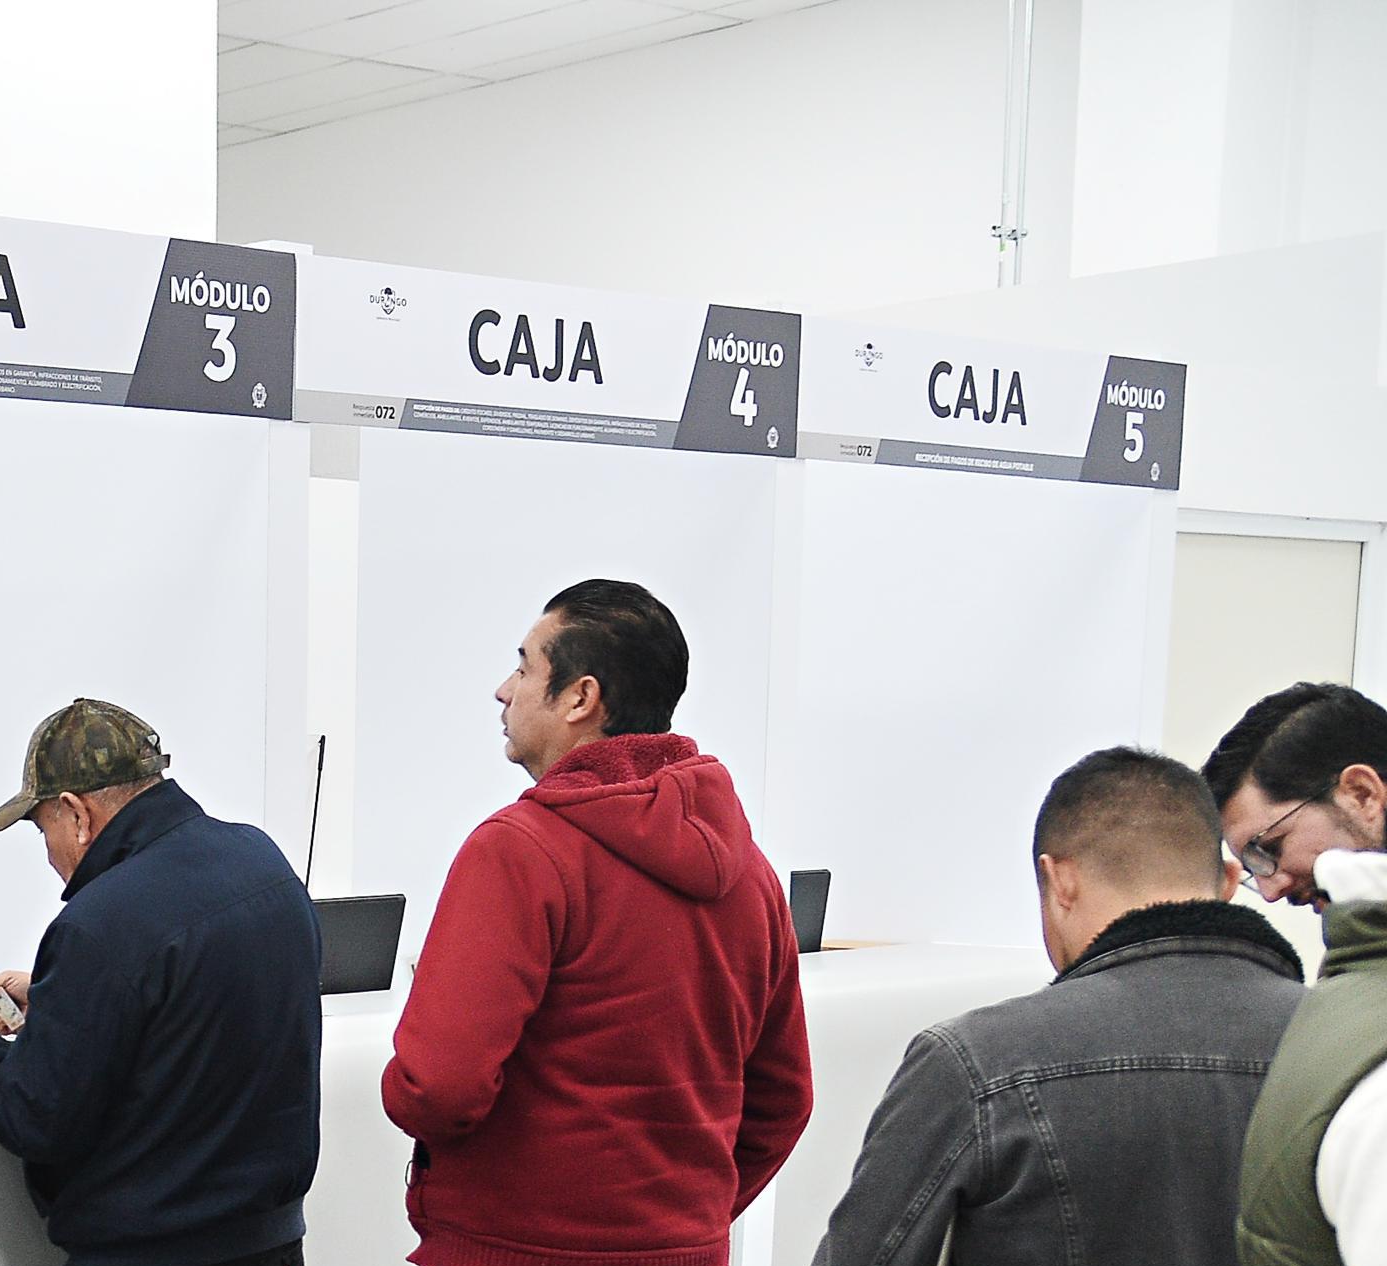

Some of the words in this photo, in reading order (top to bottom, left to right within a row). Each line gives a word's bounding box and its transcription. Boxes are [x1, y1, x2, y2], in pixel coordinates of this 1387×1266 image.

[170, 271, 271, 313] MÓDULO
[203, 313, 237, 382] 3
[468, 309, 604, 385] CAJA
[707, 332, 784, 369] MÓDULO
[375, 405, 395, 419] 072
[730, 367, 758, 427] 4
[927, 361, 1028, 426] CAJA
[1106, 380, 1166, 411] MÓDULO
[857, 445, 872, 457] 072
[1123, 411, 1145, 463] 5
